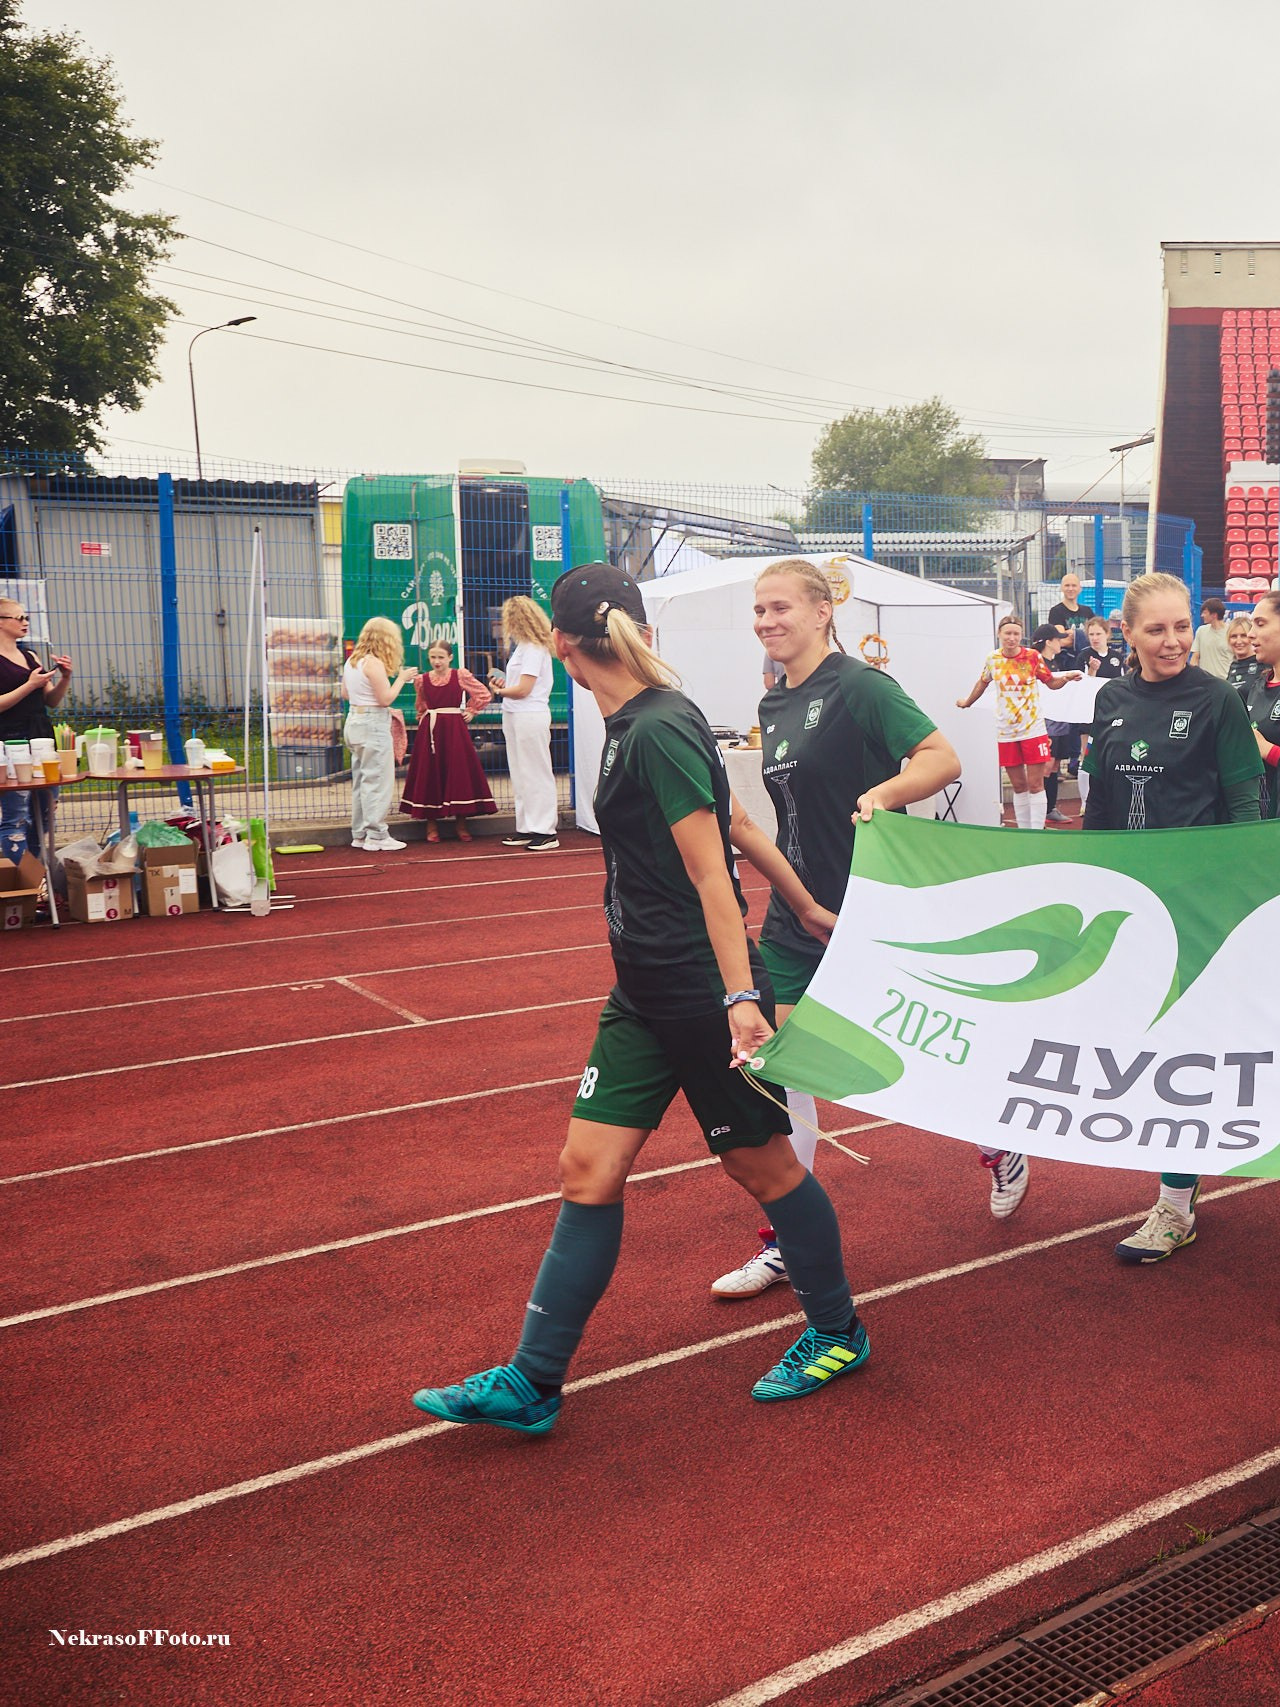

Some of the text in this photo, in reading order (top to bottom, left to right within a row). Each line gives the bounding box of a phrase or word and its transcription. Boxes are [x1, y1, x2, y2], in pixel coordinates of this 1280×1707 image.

[1037, 742, 1049, 757] 15
[763, 760, 798, 775] АДВАПЛАСТ
[1114, 764, 1165, 773] АДВАПЛАСТ
[872, 988, 976, 1066] 2025
[1007, 1038, 1274, 1107] ДУСТ
[998, 1096, 1261, 1150] moms
[710, 1125, 732, 1137] GS
